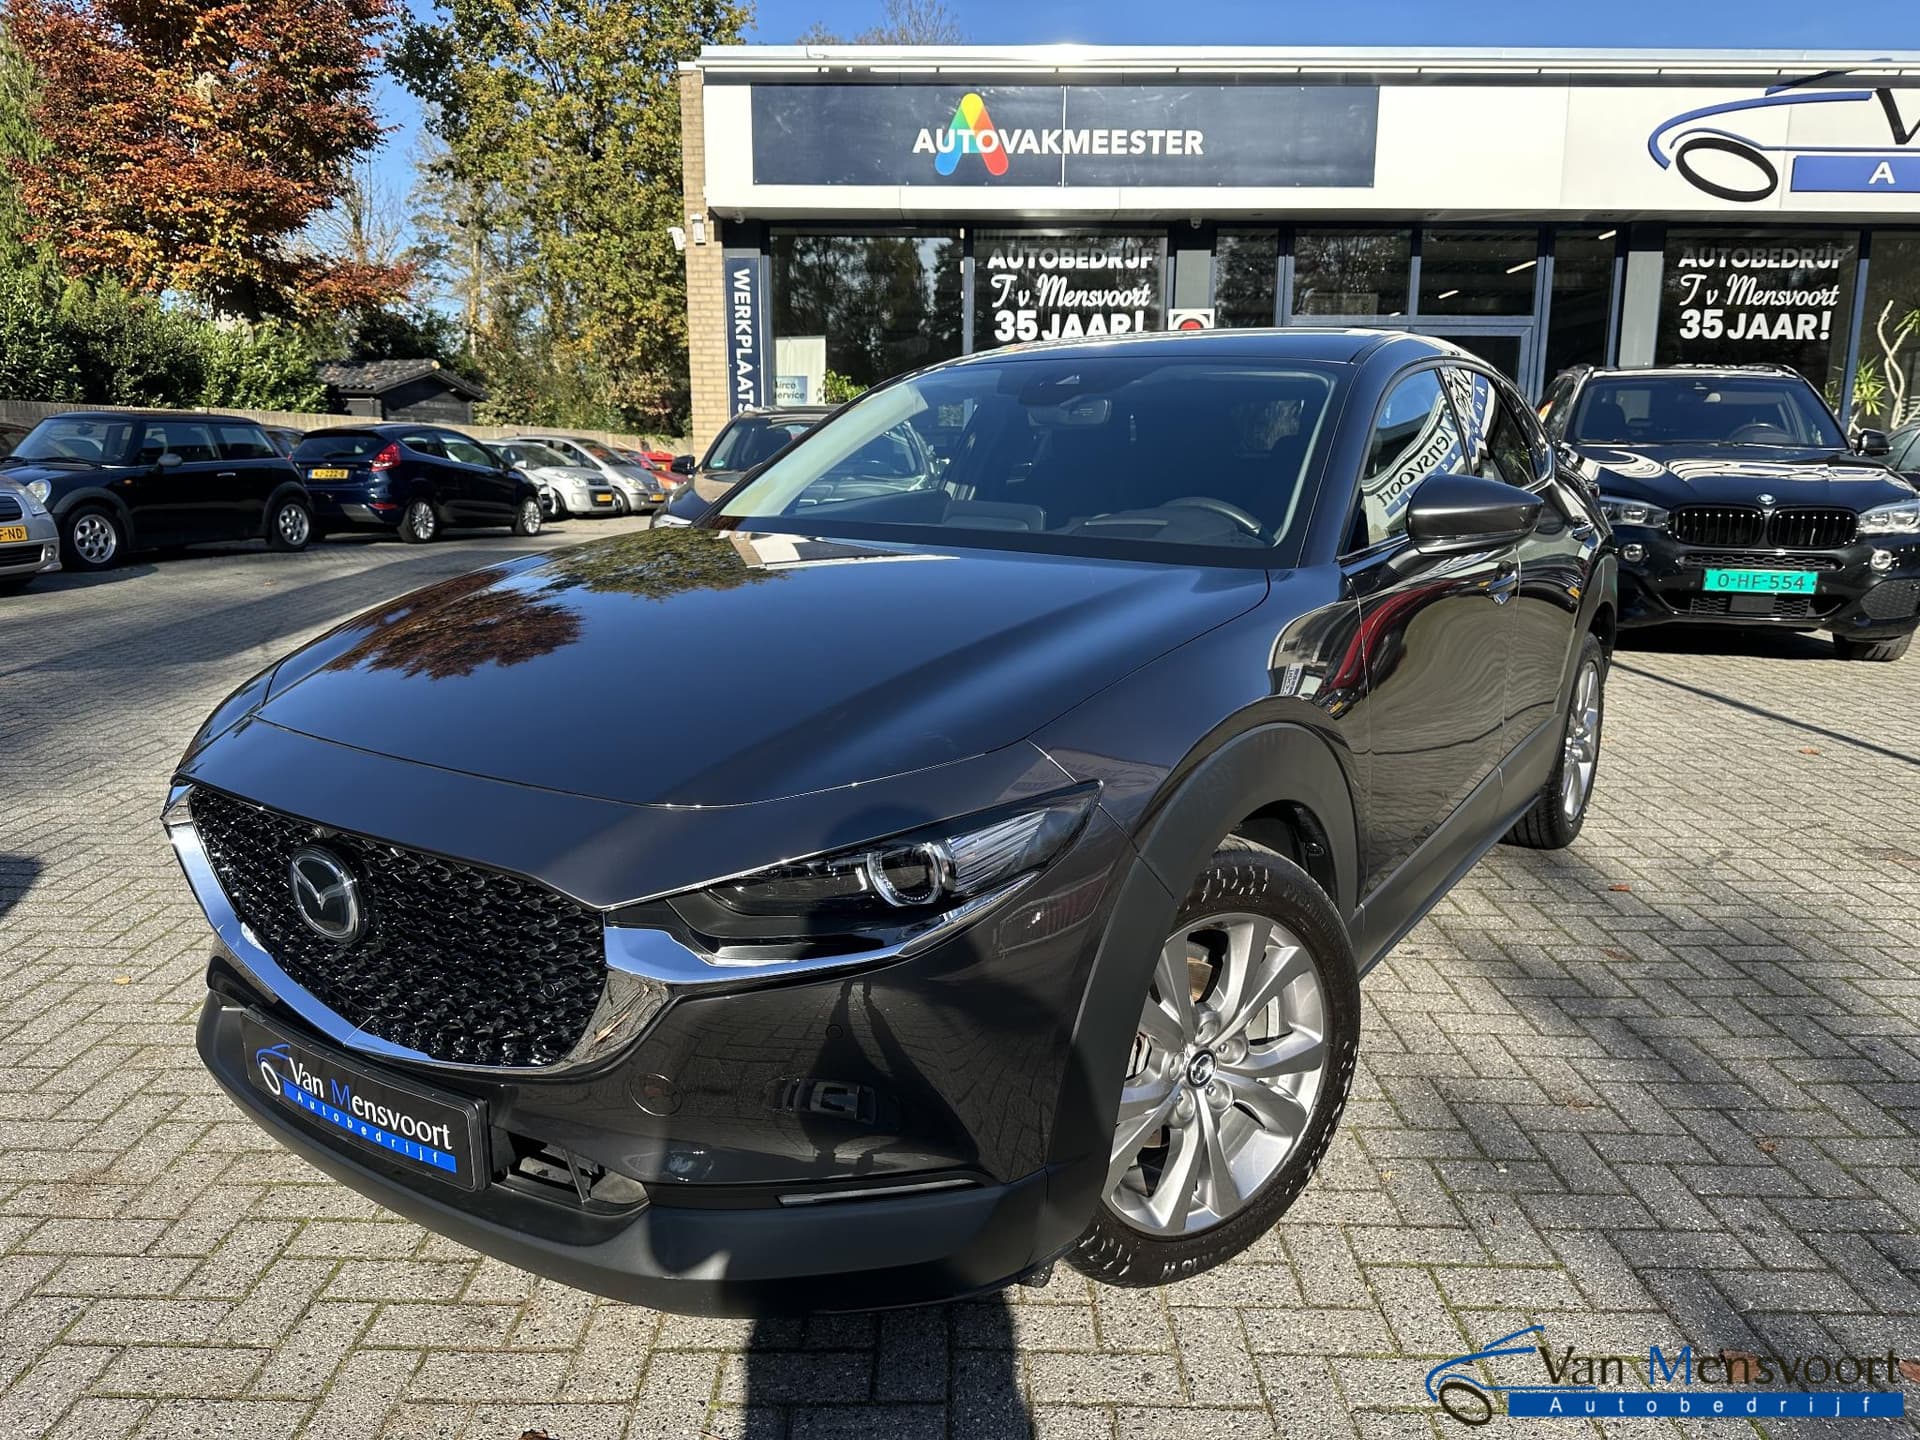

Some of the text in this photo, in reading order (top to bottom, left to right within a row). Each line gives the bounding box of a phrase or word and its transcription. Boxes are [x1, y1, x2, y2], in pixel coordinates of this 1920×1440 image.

[912, 128, 1204, 155] AUTOVAKMEESTER
[1868, 160, 1896, 185] A
[1037, 273, 1151, 307] Mensvoort
[1726, 273, 1840, 306] Mensvoort
[733, 268, 755, 414] WERKPLAATS
[994, 310, 1038, 342] 35
[1679, 309, 1832, 341] 35 JAAR!
[288, 1057, 453, 1151] Van Mensvoort
[297, 1091, 439, 1163] Autobedrijf
